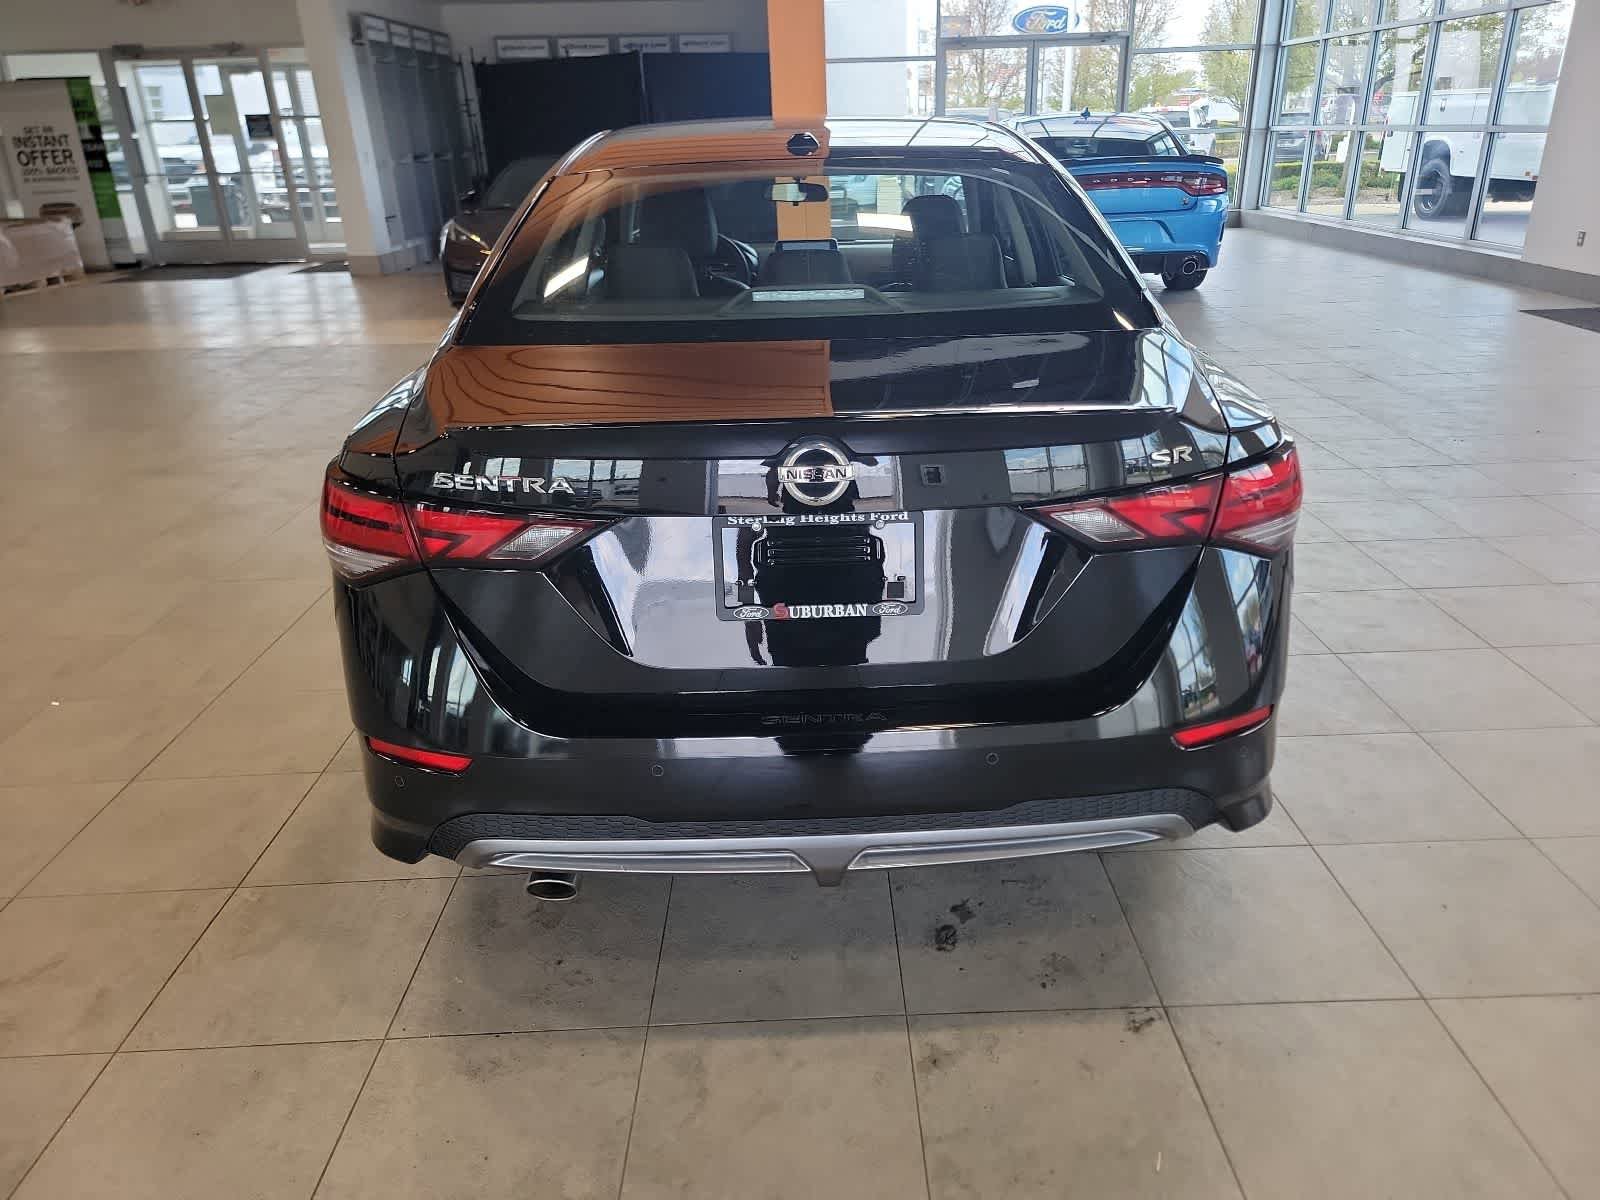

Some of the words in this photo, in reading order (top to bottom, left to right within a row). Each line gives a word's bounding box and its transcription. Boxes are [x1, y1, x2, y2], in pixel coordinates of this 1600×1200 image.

[1025, 10, 1066, 31] Ford
[12, 134, 69, 148] INSTANT
[16, 148, 74, 167] OFFER
[1151, 446, 1193, 467] SR
[432, 471, 576, 495] SENTRA
[786, 468, 847, 480] NISSAN
[727, 515, 796, 526] Sterlg
[799, 513, 865, 524] Heights
[870, 511, 909, 522] Ford
[773, 603, 868, 621] SUBURBAN
[761, 711, 888, 725] SENTRA
